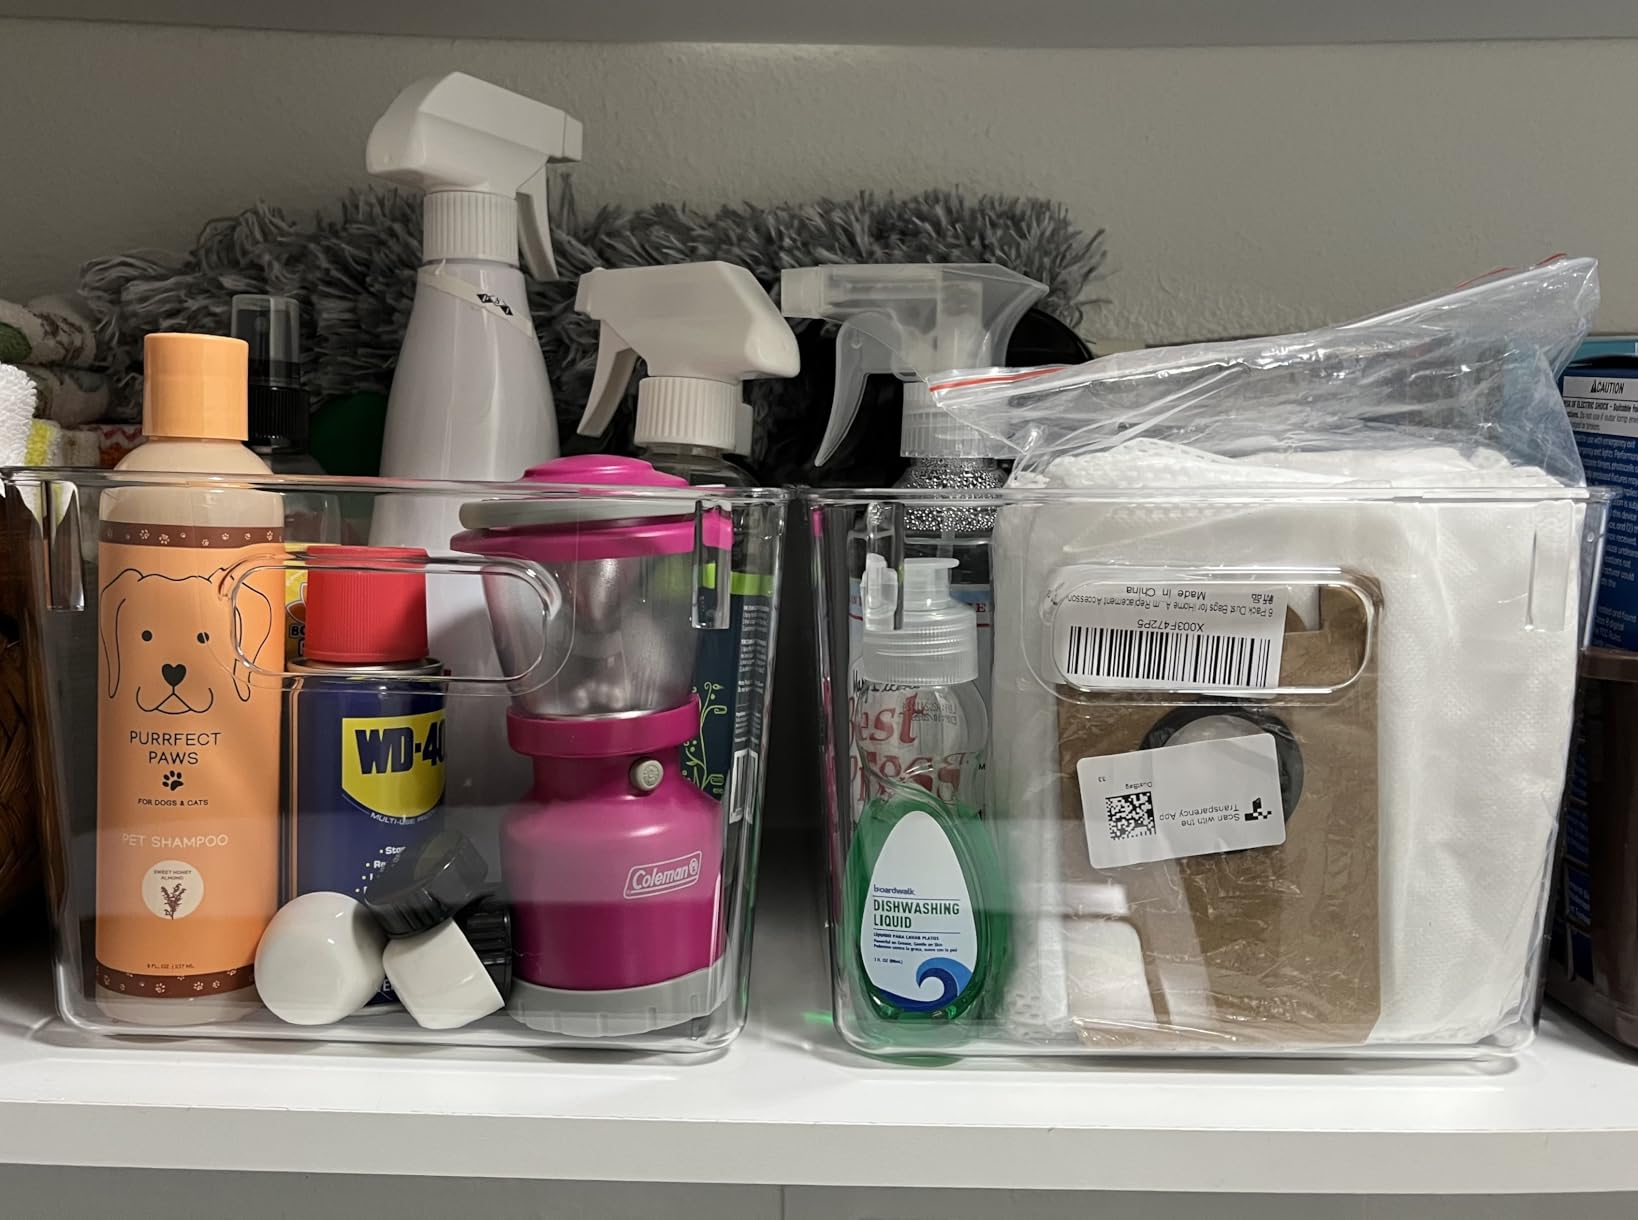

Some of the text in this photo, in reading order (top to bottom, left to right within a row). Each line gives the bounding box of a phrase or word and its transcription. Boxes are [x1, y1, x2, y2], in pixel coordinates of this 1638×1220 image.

[1597, 382, 1625, 394] CAUTION
[1126, 586, 1156, 597] China
[1178, 589, 1206, 601] Made
[1104, 597, 1150, 609] Replacement
[1198, 603, 1208, 612] for
[1209, 602, 1228, 614] Bags
[1230, 605, 1246, 615] Dust
[1249, 607, 1266, 617] Pack
[1268, 608, 1273, 617] 6
[1137, 619, 1204, 632] X003F472P5
[130, 730, 221, 746] PURRFECT
[148, 751, 199, 765] PAWS
[137, 798, 153, 806] FOR
[155, 799, 177, 807] DOGS
[1159, 803, 1239, 821] Transparency App
[1181, 812, 1240, 827] Scan with the
[122, 833, 229, 849] PET SHAMPOO
[385, 846, 407, 855] Sto
[632, 864, 688, 890] Coleman
[873, 899, 960, 915] DISHWASHING
[873, 914, 912, 928] LIQUID
